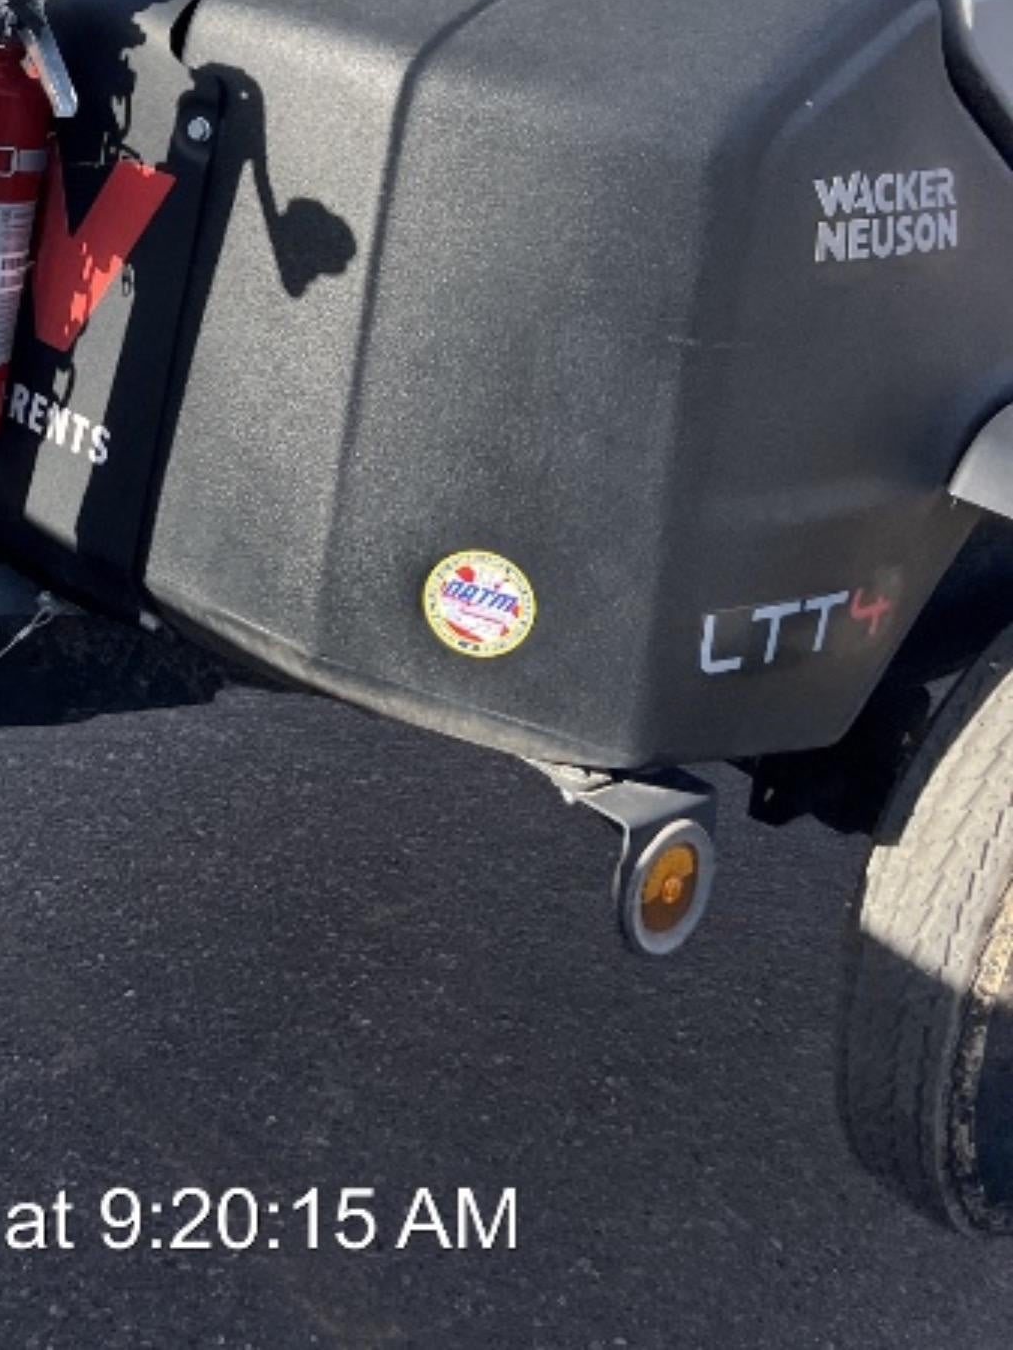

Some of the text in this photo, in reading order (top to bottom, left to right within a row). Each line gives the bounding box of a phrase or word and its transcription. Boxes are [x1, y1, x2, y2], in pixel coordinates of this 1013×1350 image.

[813, 167, 956, 217] WACKER
[814, 209, 957, 263] NEUSON
[8, 382, 111, 466] RENTS
